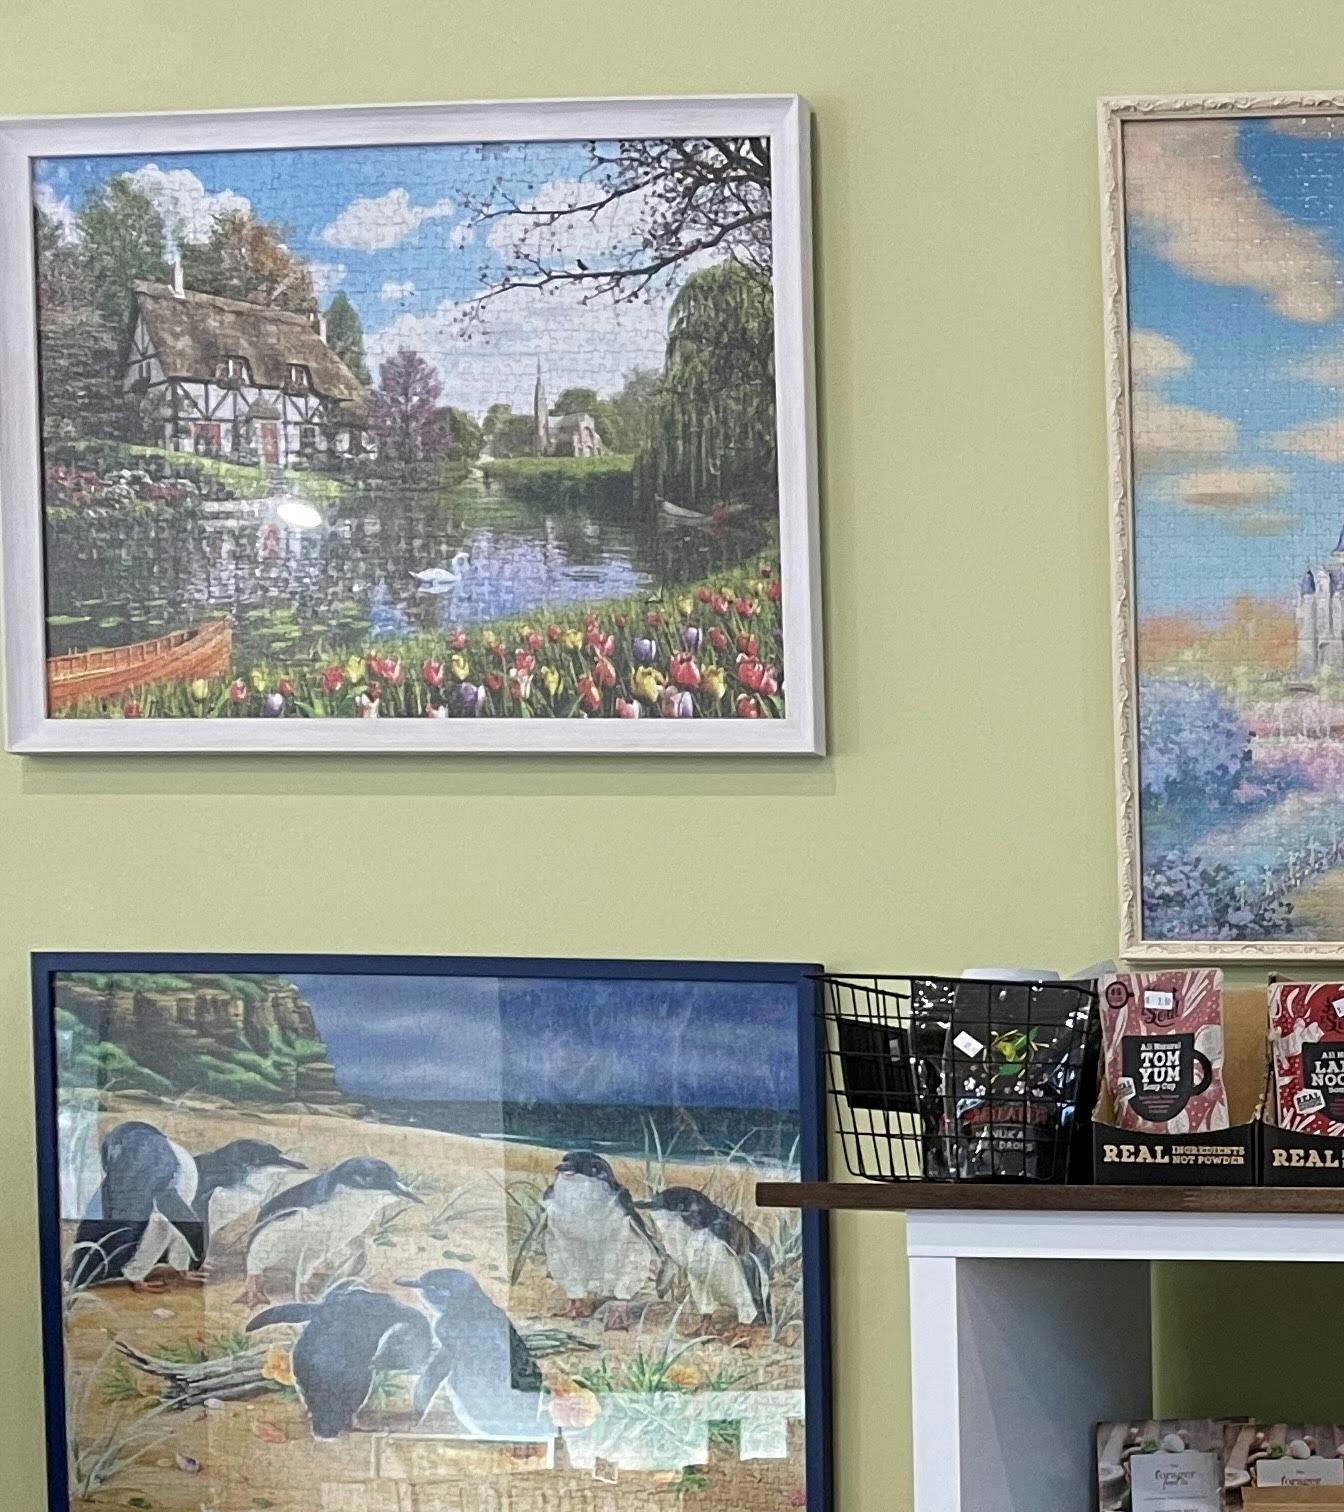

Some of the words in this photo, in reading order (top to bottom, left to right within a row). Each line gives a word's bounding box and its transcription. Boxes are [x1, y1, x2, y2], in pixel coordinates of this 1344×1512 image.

[1140, 1051, 1180, 1066] TOM
[1139, 1067, 1180, 1082] YUM
[1103, 1145, 1169, 1163] REAL
[1172, 1146, 1245, 1155] INGREDIENTS
[1173, 1156, 1195, 1164] NOT
[1198, 1156, 1243, 1165] POWDER
[1273, 1149, 1339, 1167] REAL
